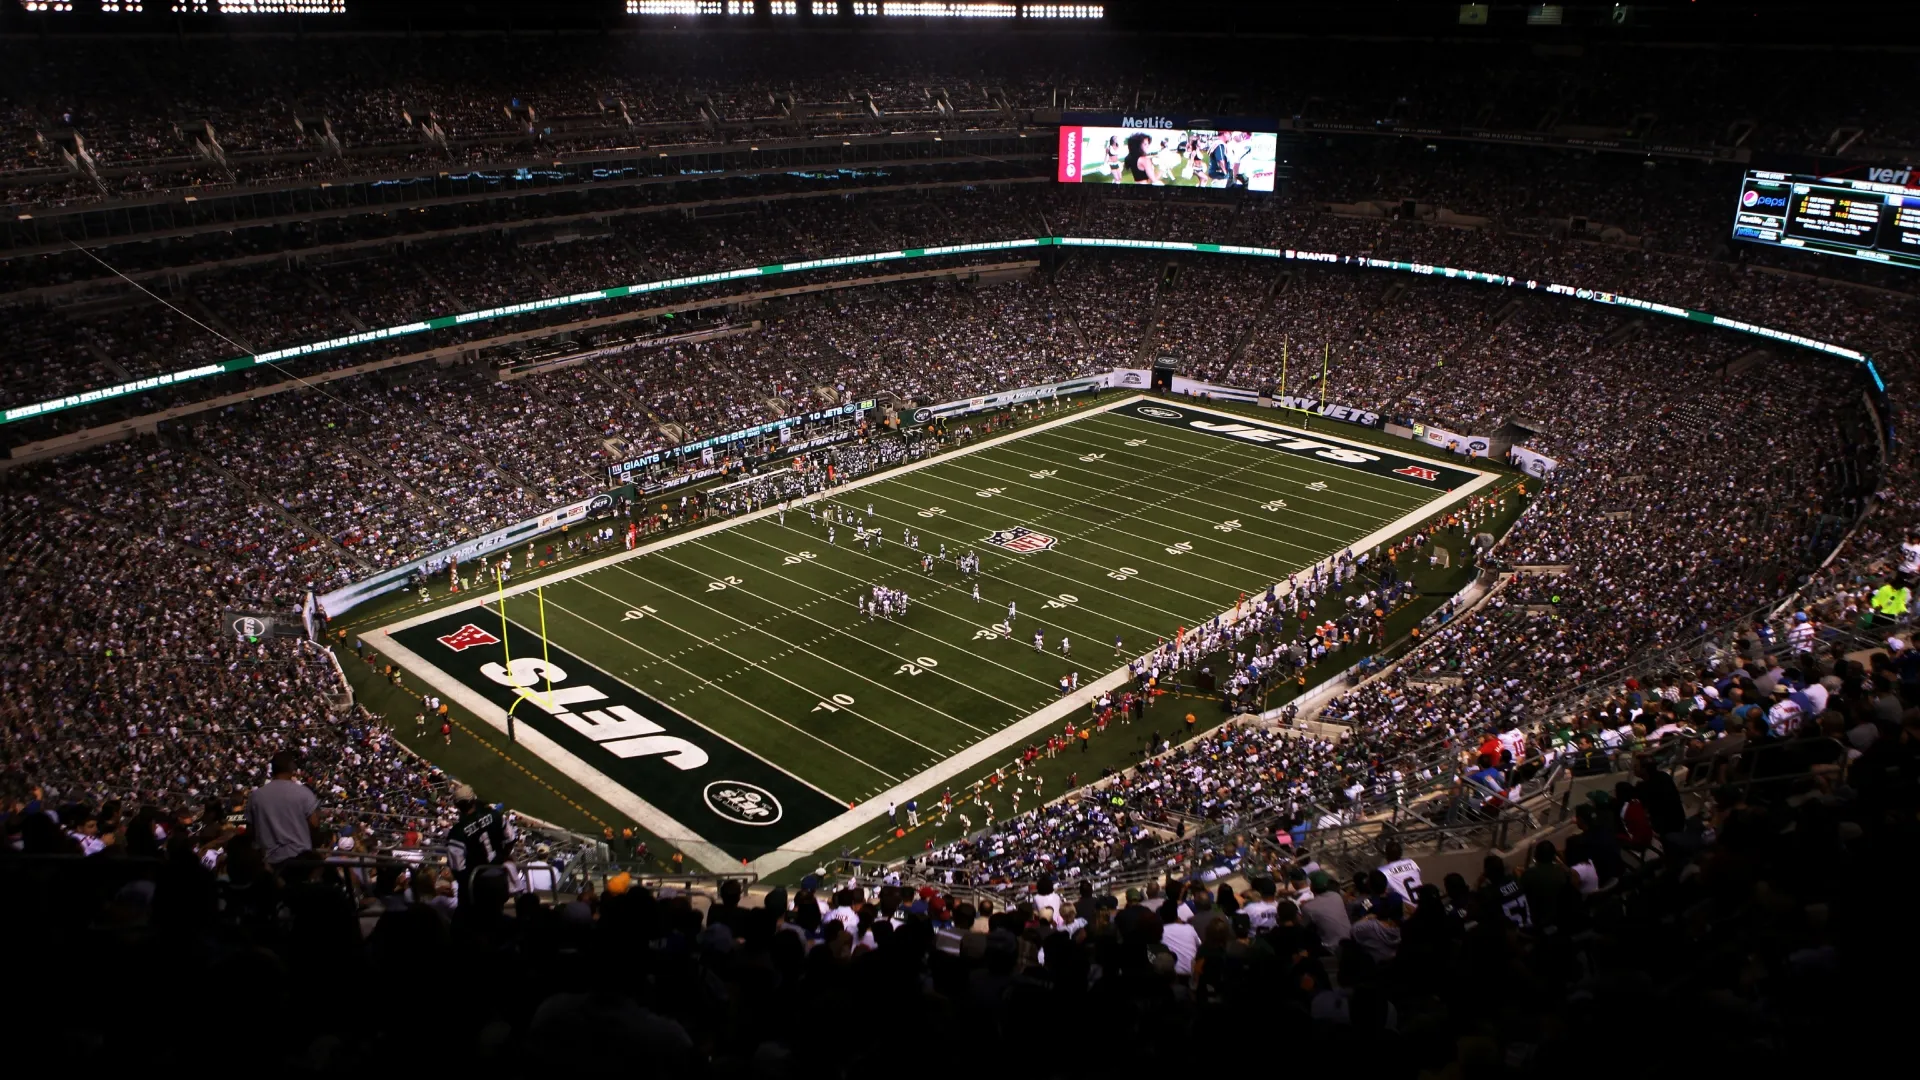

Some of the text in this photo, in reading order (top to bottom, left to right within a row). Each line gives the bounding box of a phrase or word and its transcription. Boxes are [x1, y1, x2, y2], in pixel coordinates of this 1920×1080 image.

[1122, 116, 1172, 128] MetLife
[1068, 132, 1076, 164] TOYOTA
[1758, 196, 1786, 206] pepsi
[1297, 252, 1337, 263] GIANTS
[809, 412, 820, 420] 10
[823, 407, 843, 418] JETS
[1318, 403, 1379, 426] JETS
[788, 442, 809, 453] NEW
[1190, 420, 1380, 463] JETS
[624, 454, 660, 470] GIANTS
[664, 451, 671, 459] 7
[1079, 453, 1102, 463] 20
[1030, 469, 1054, 480] 30
[664, 476, 690, 488] NEW
[976, 487, 1002, 498] 40
[920, 506, 946, 518] 50
[1261, 500, 1286, 512] 20
[1214, 520, 1240, 532] 30
[1004, 535, 1050, 550] NFL
[1166, 542, 1191, 554] 40
[787, 551, 817, 564] 30
[1107, 566, 1139, 580] 50
[710, 576, 743, 591] 20
[1047, 592, 1078, 610] 40
[630, 605, 658, 620] 10
[904, 656, 938, 678] 20
[820, 693, 856, 712] 10
[480, 657, 709, 770] JETS
[1502, 894, 1533, 928] 57
